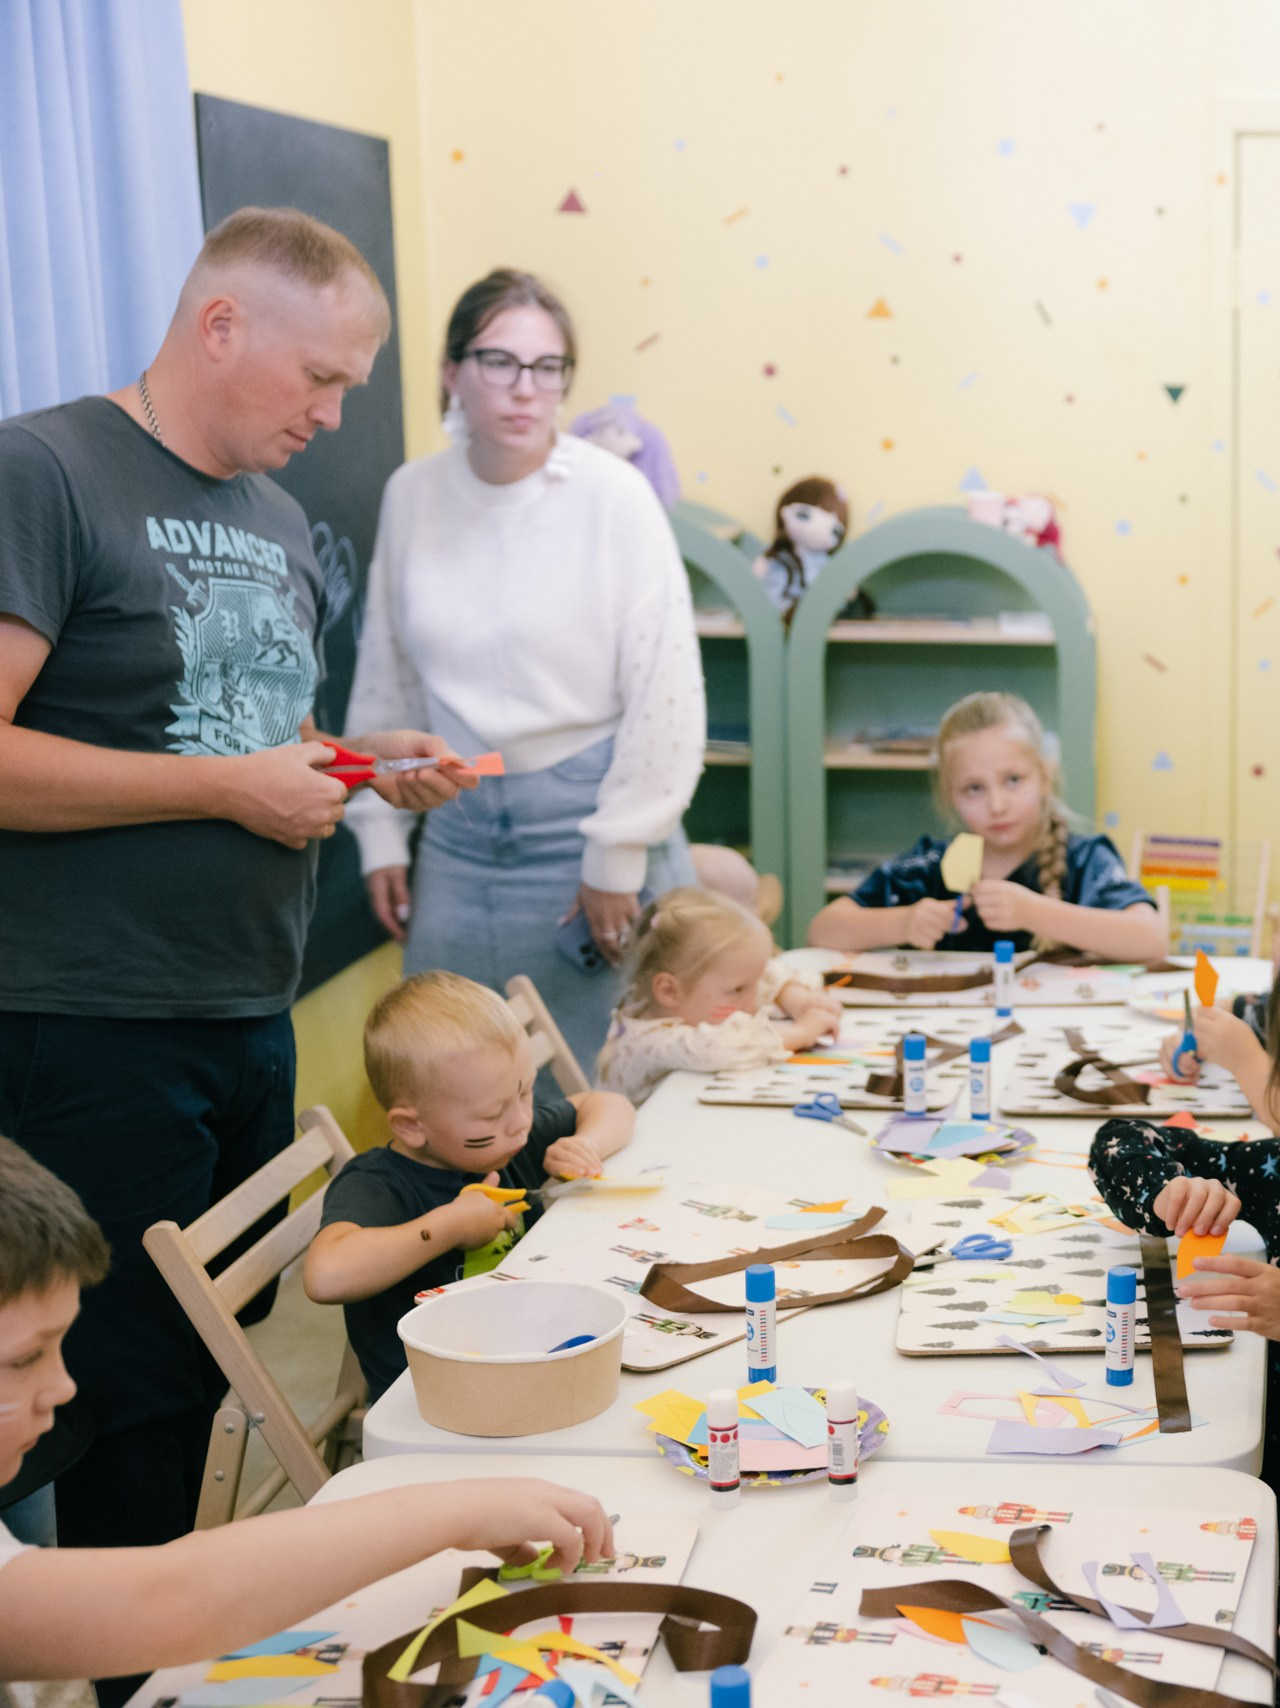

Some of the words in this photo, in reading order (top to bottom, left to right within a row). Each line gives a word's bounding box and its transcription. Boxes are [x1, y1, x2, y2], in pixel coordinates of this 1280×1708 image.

[146, 516, 288, 577] ADVANCED
[188, 558, 250, 577] ANOTHER
[214, 728, 241, 752] FOR
